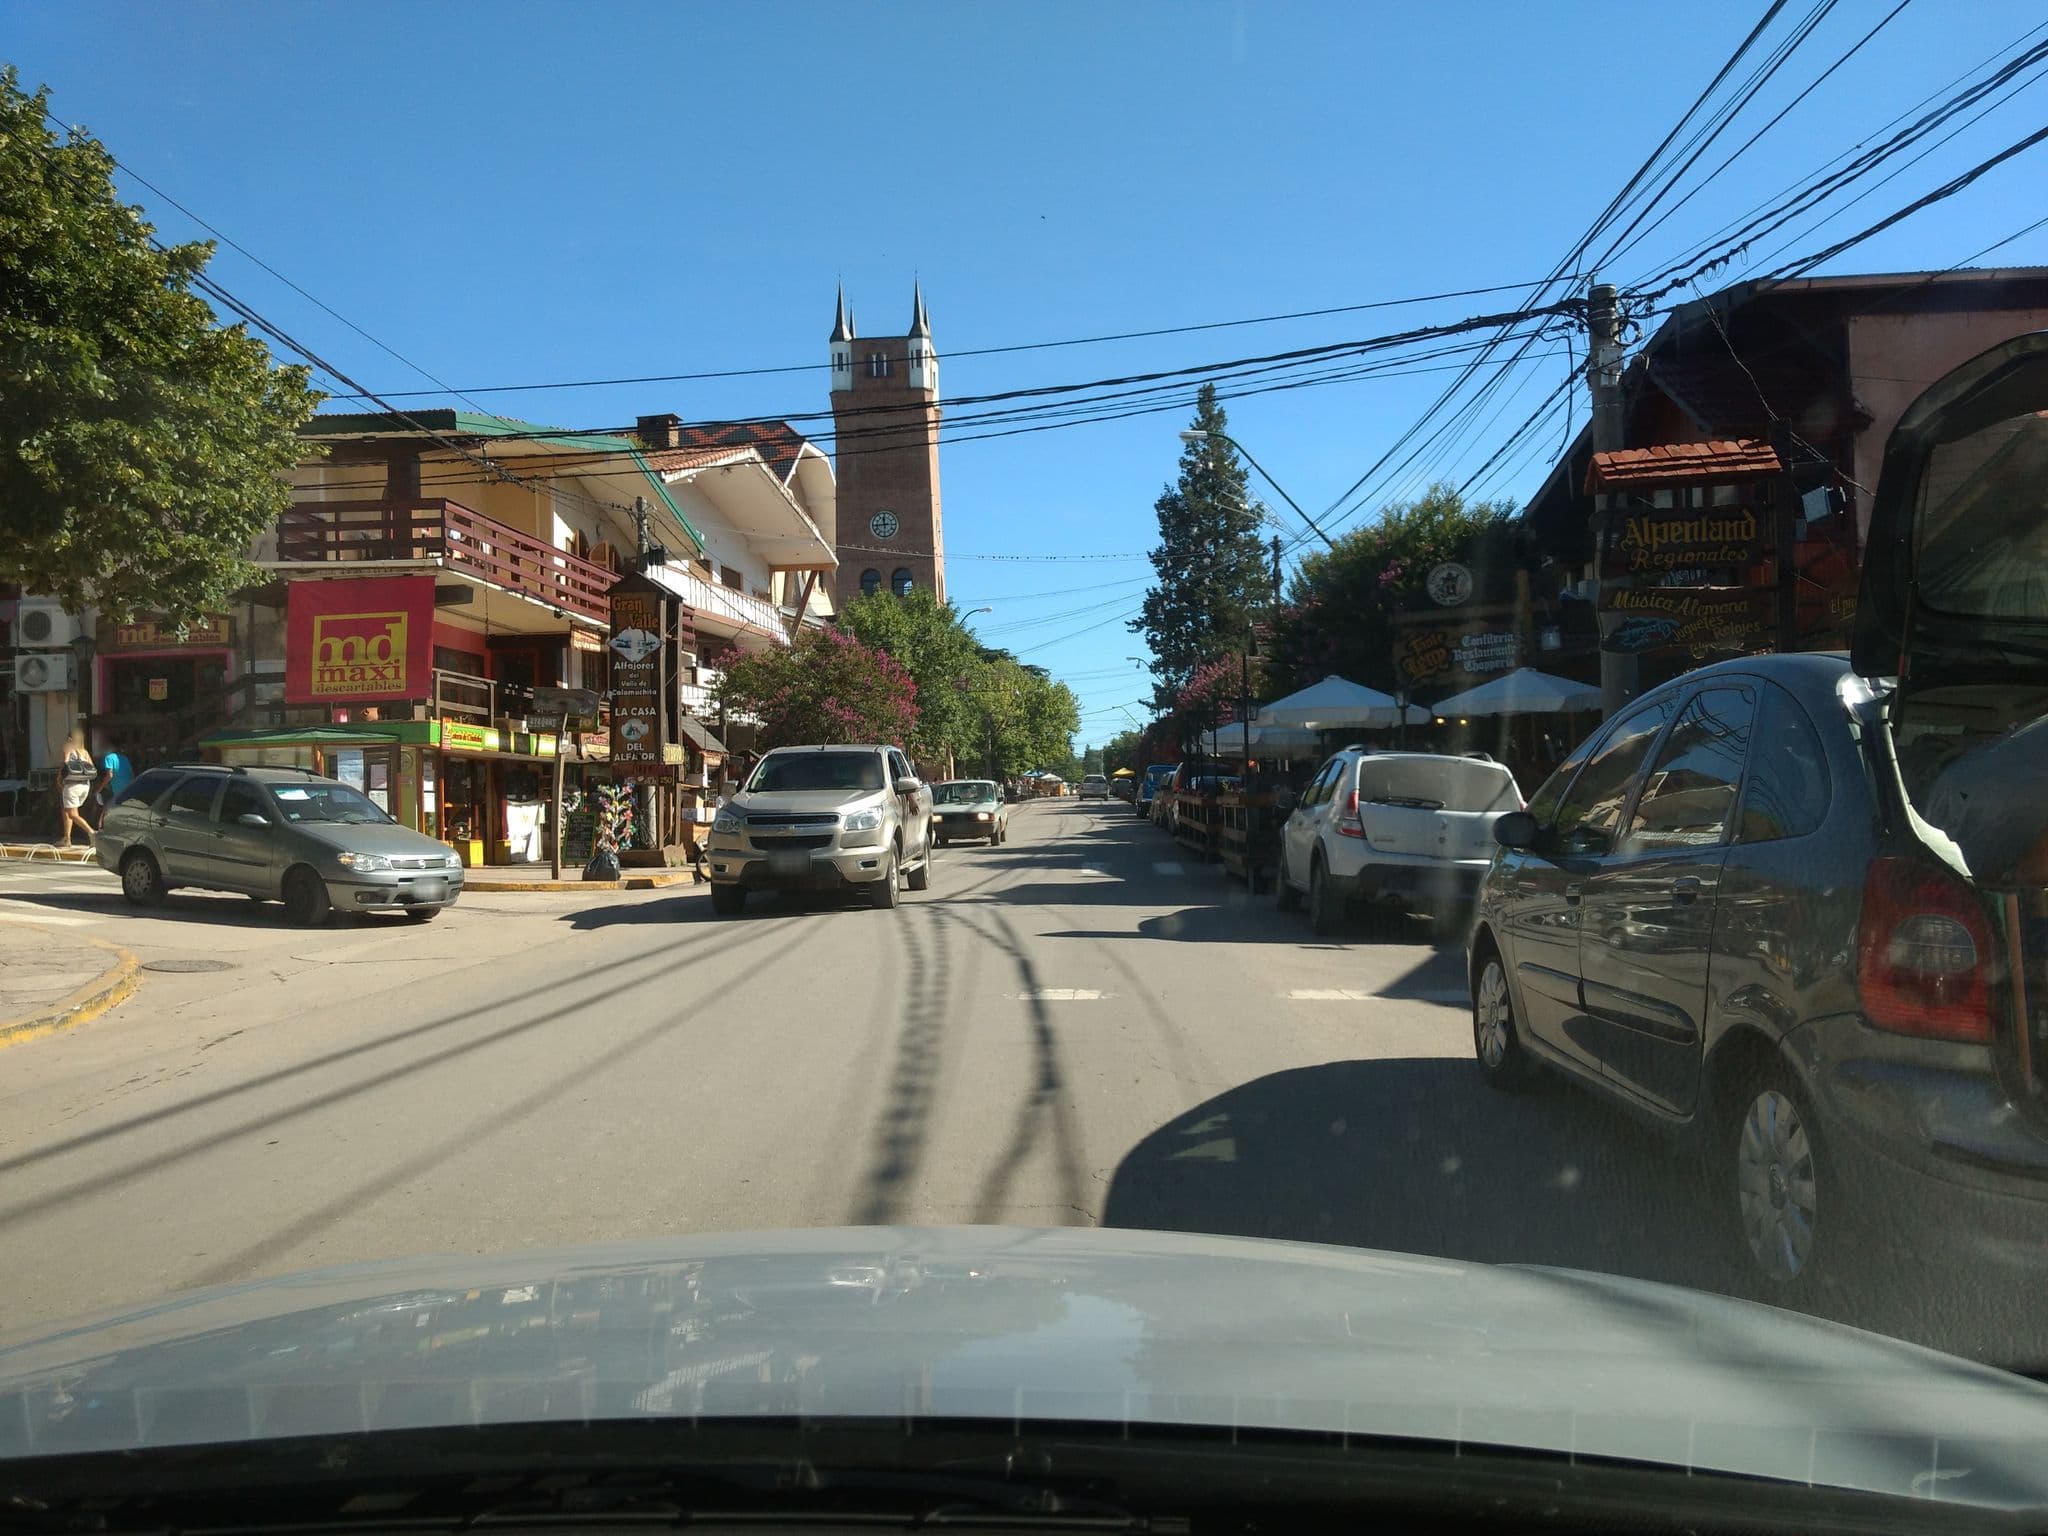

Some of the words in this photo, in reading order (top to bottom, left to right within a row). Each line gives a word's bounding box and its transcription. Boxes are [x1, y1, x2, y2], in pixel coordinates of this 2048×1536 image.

[1620, 508, 1756, 552] Alpenland
[1629, 544, 1749, 570] Regionales
[612, 596, 642, 613] Gran
[1675, 597, 1748, 616] Alemana
[630, 612, 659, 629] Valle
[1672, 615, 1724, 642] Juguetes
[320, 623, 403, 667] md
[317, 659, 402, 683] maxi
[614, 661, 655, 670] Alfajores
[317, 680, 402, 693] descartables
[614, 707, 628, 717] LA
[630, 707, 657, 716] CASA
[626, 743, 645, 751] DEL
